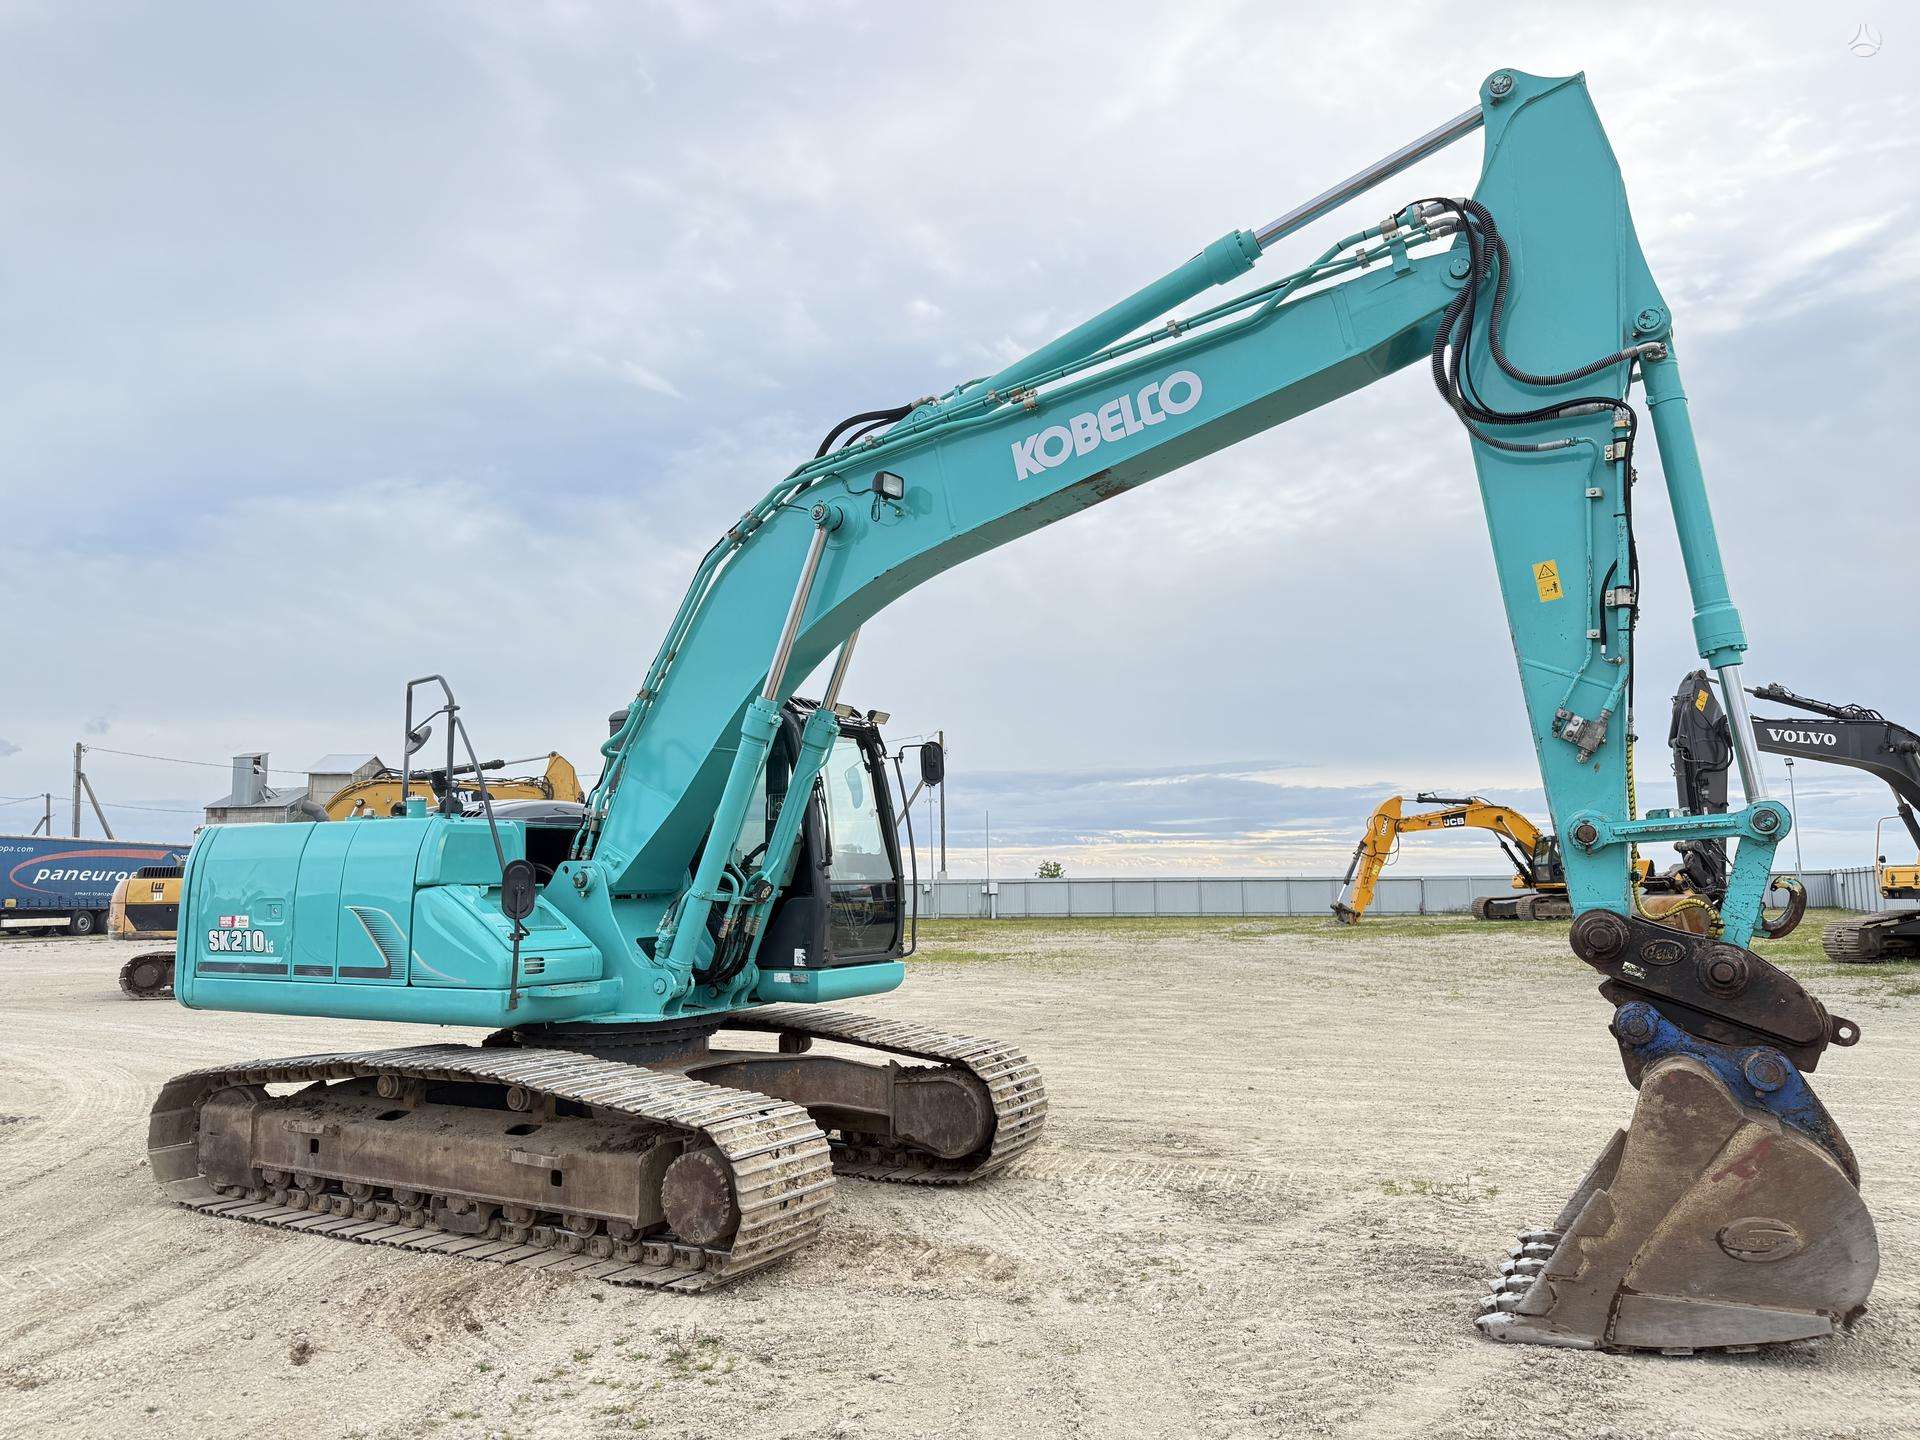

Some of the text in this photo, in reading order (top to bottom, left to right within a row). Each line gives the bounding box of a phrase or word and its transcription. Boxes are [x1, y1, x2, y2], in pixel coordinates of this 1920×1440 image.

[1011, 370, 1203, 481] KOBELCO
[1766, 728, 1837, 746] VOLVO
[1443, 817, 1465, 827] JCB
[208, 929, 265, 952] SK210
